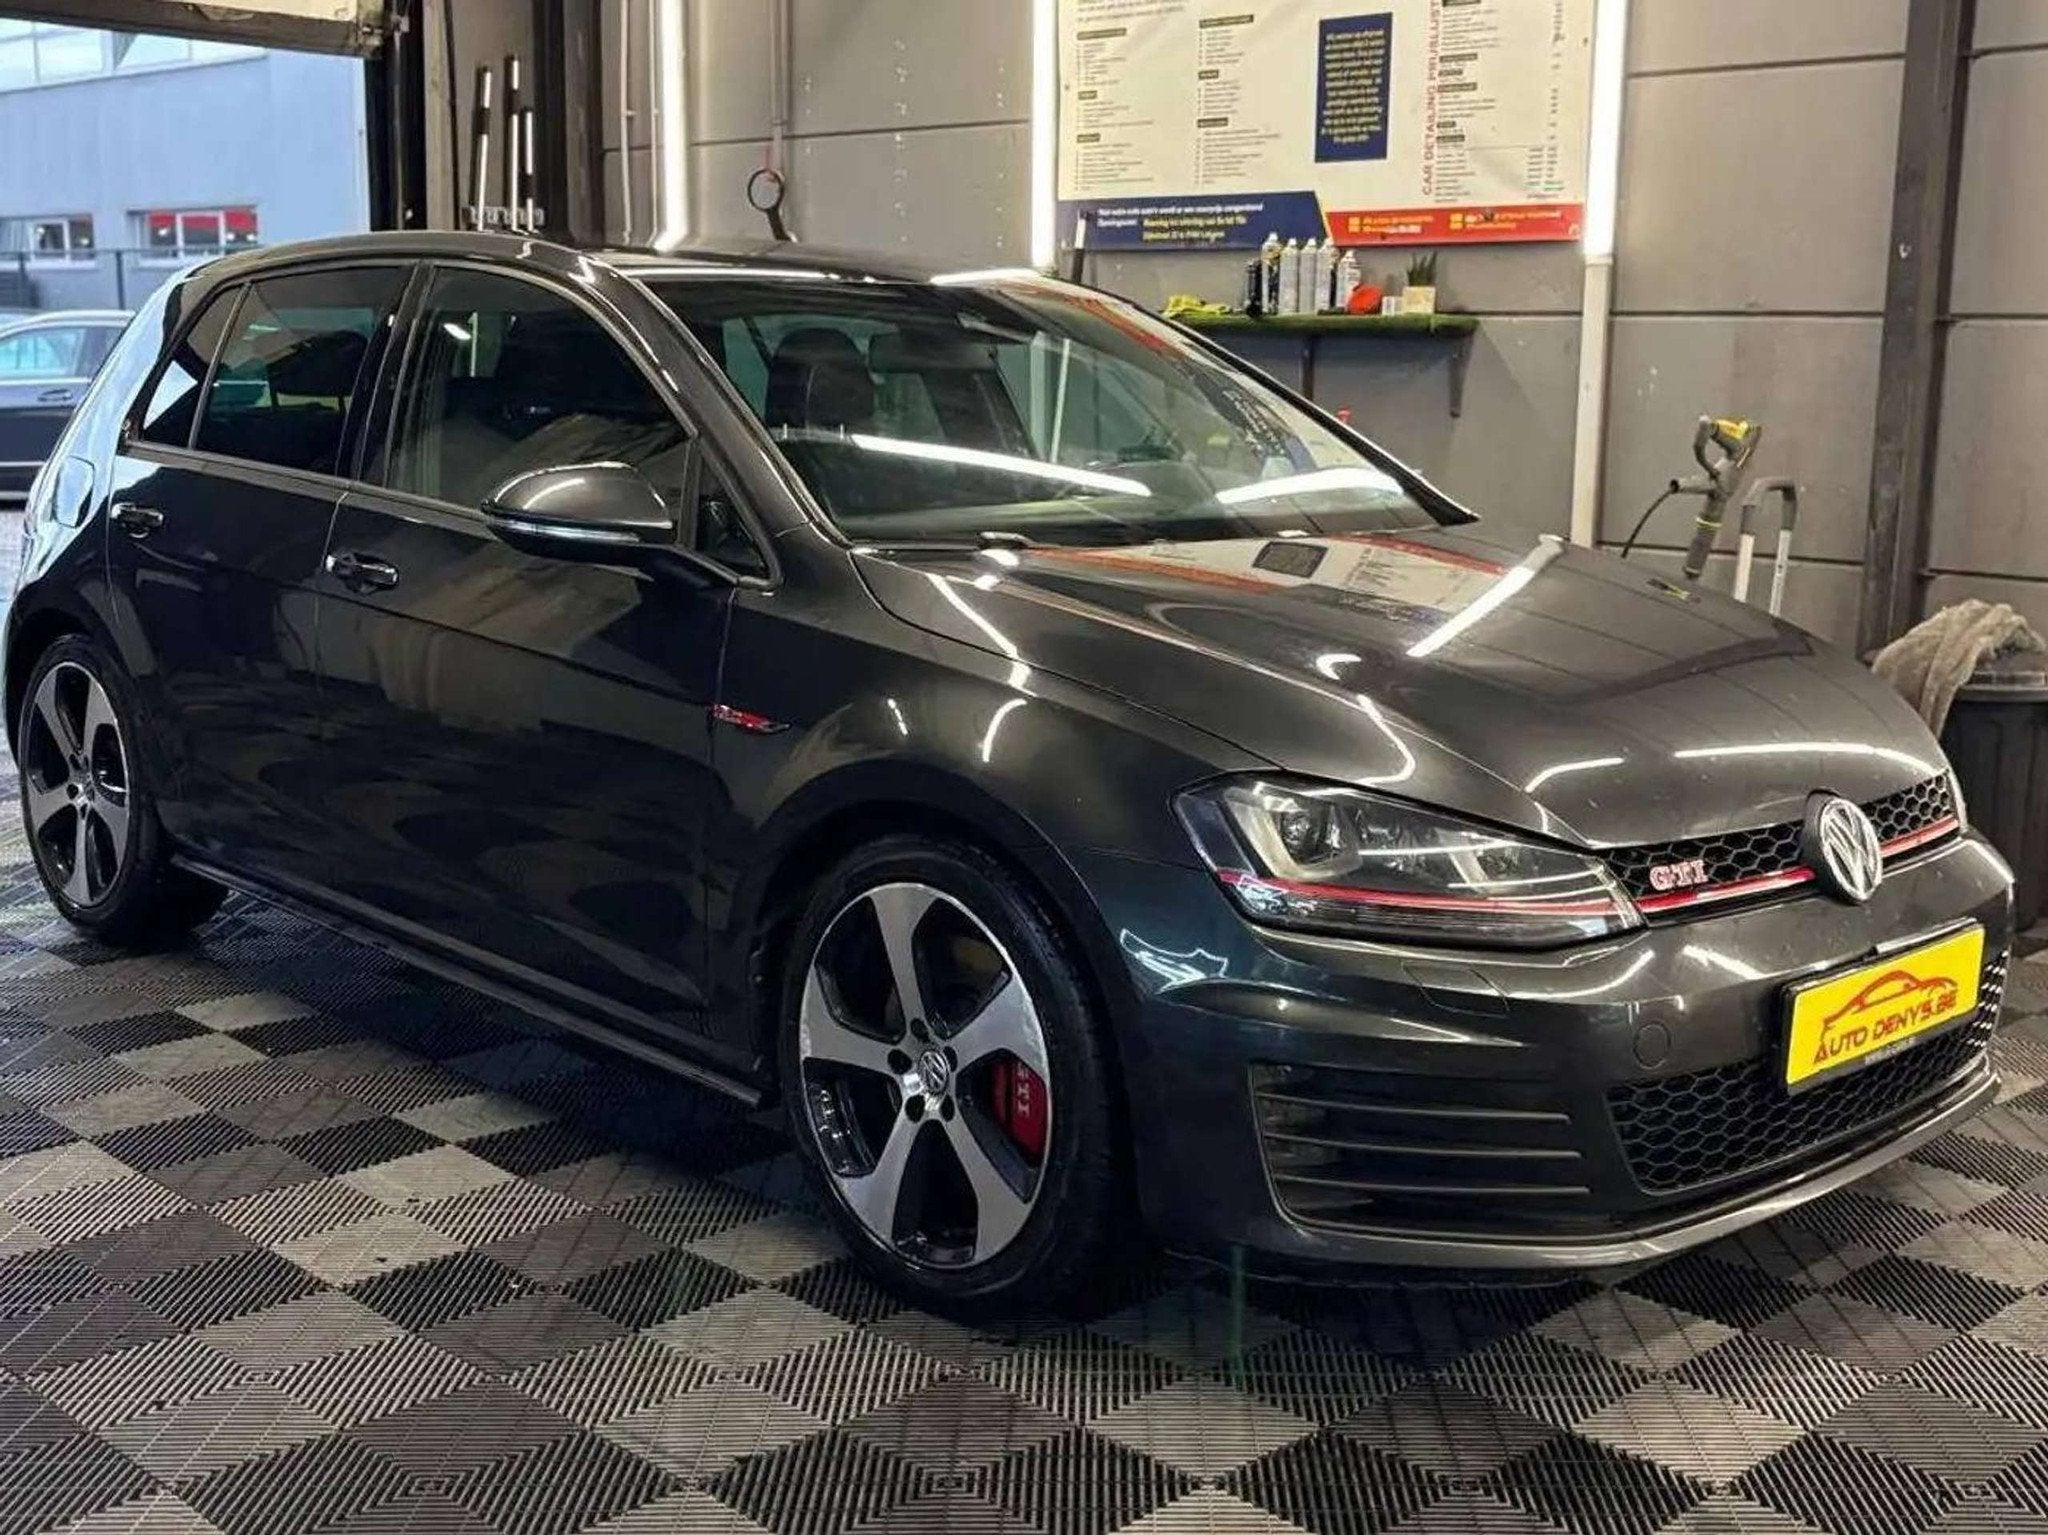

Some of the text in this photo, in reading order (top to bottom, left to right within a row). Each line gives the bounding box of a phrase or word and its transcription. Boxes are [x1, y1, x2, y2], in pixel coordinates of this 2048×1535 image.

[1422, 167, 1432, 195] CAR
[1649, 858, 1709, 891] GTI
[1813, 1025, 1868, 1065] AUTO
[1872, 989, 1958, 1041] DENYS.BE
